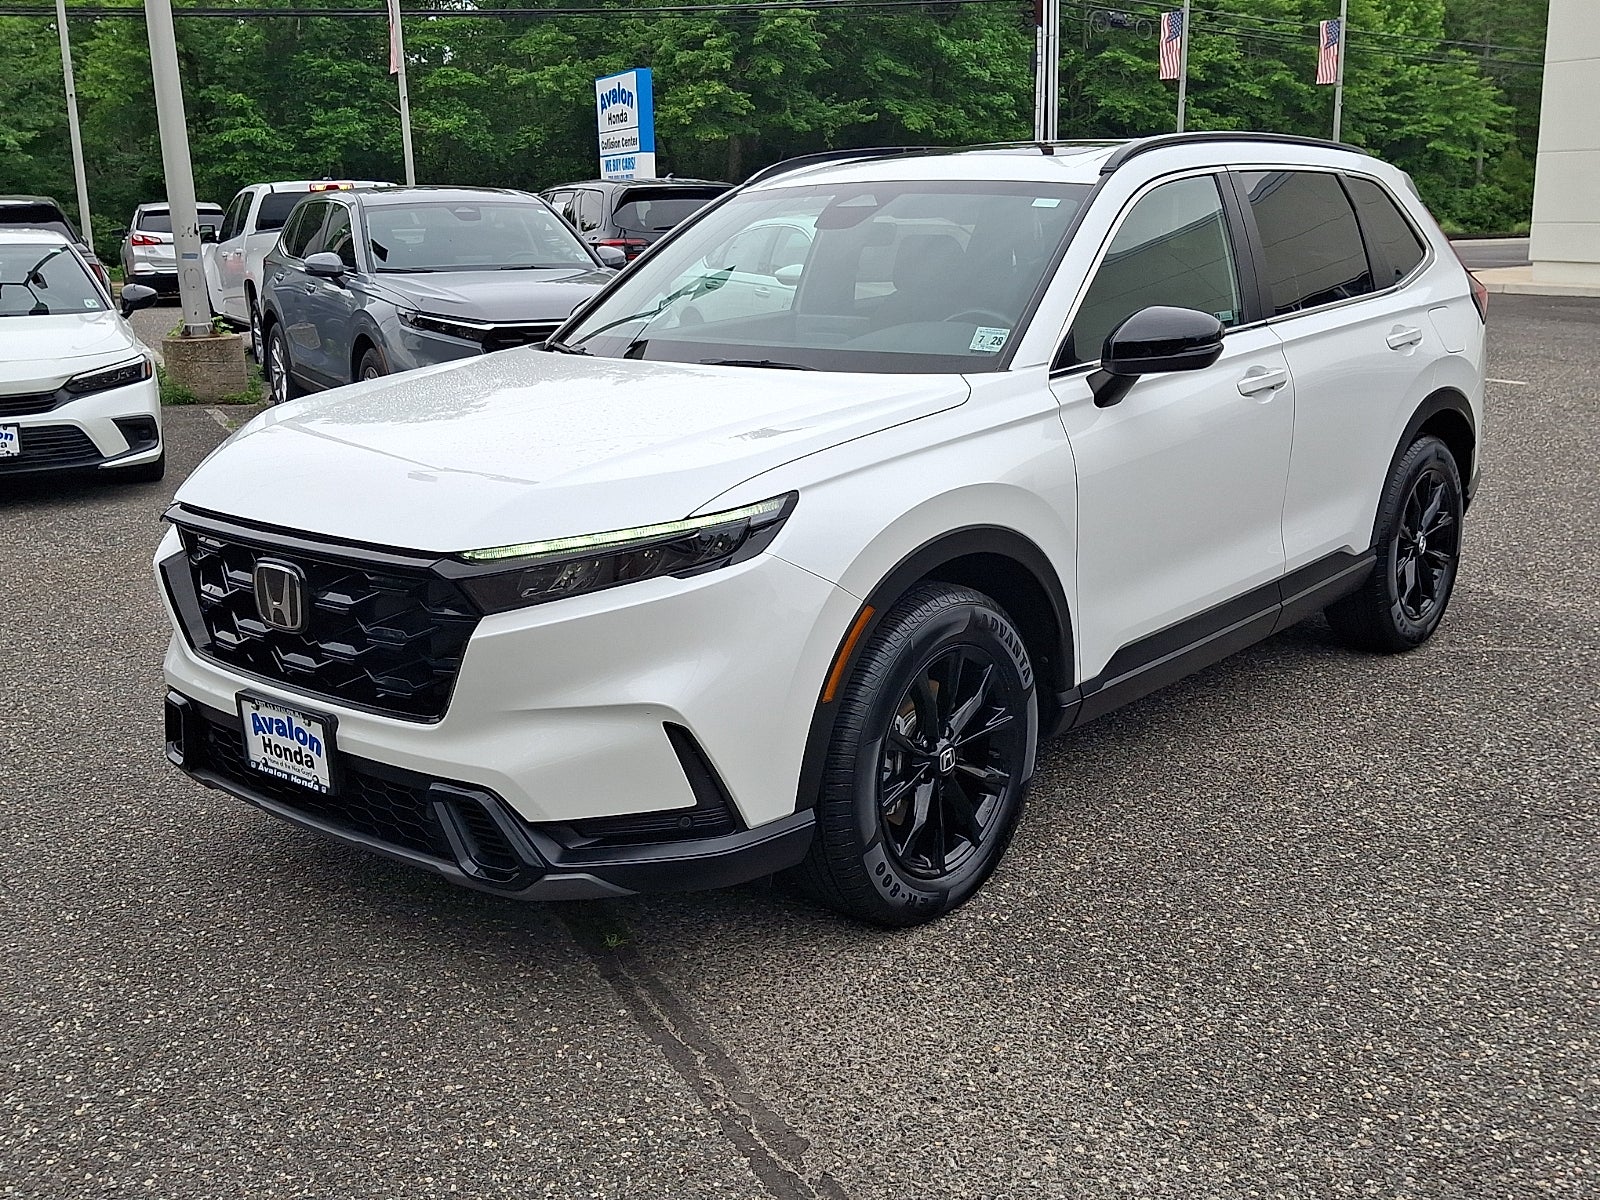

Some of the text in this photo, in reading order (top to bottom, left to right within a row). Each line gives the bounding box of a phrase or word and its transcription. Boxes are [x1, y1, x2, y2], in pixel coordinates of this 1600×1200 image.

[600, 82, 634, 115] Avalon
[607, 109, 628, 126] Honda
[601, 136, 638, 151] Collision Center
[605, 159, 612, 173] WE
[612, 158, 621, 172] BUY
[990, 336, 1004, 346] 28
[979, 613, 1032, 684] ADVANTA
[251, 712, 322, 758] Avalon
[261, 735, 315, 770] Honda
[258, 763, 319, 791] Avalon Honda
